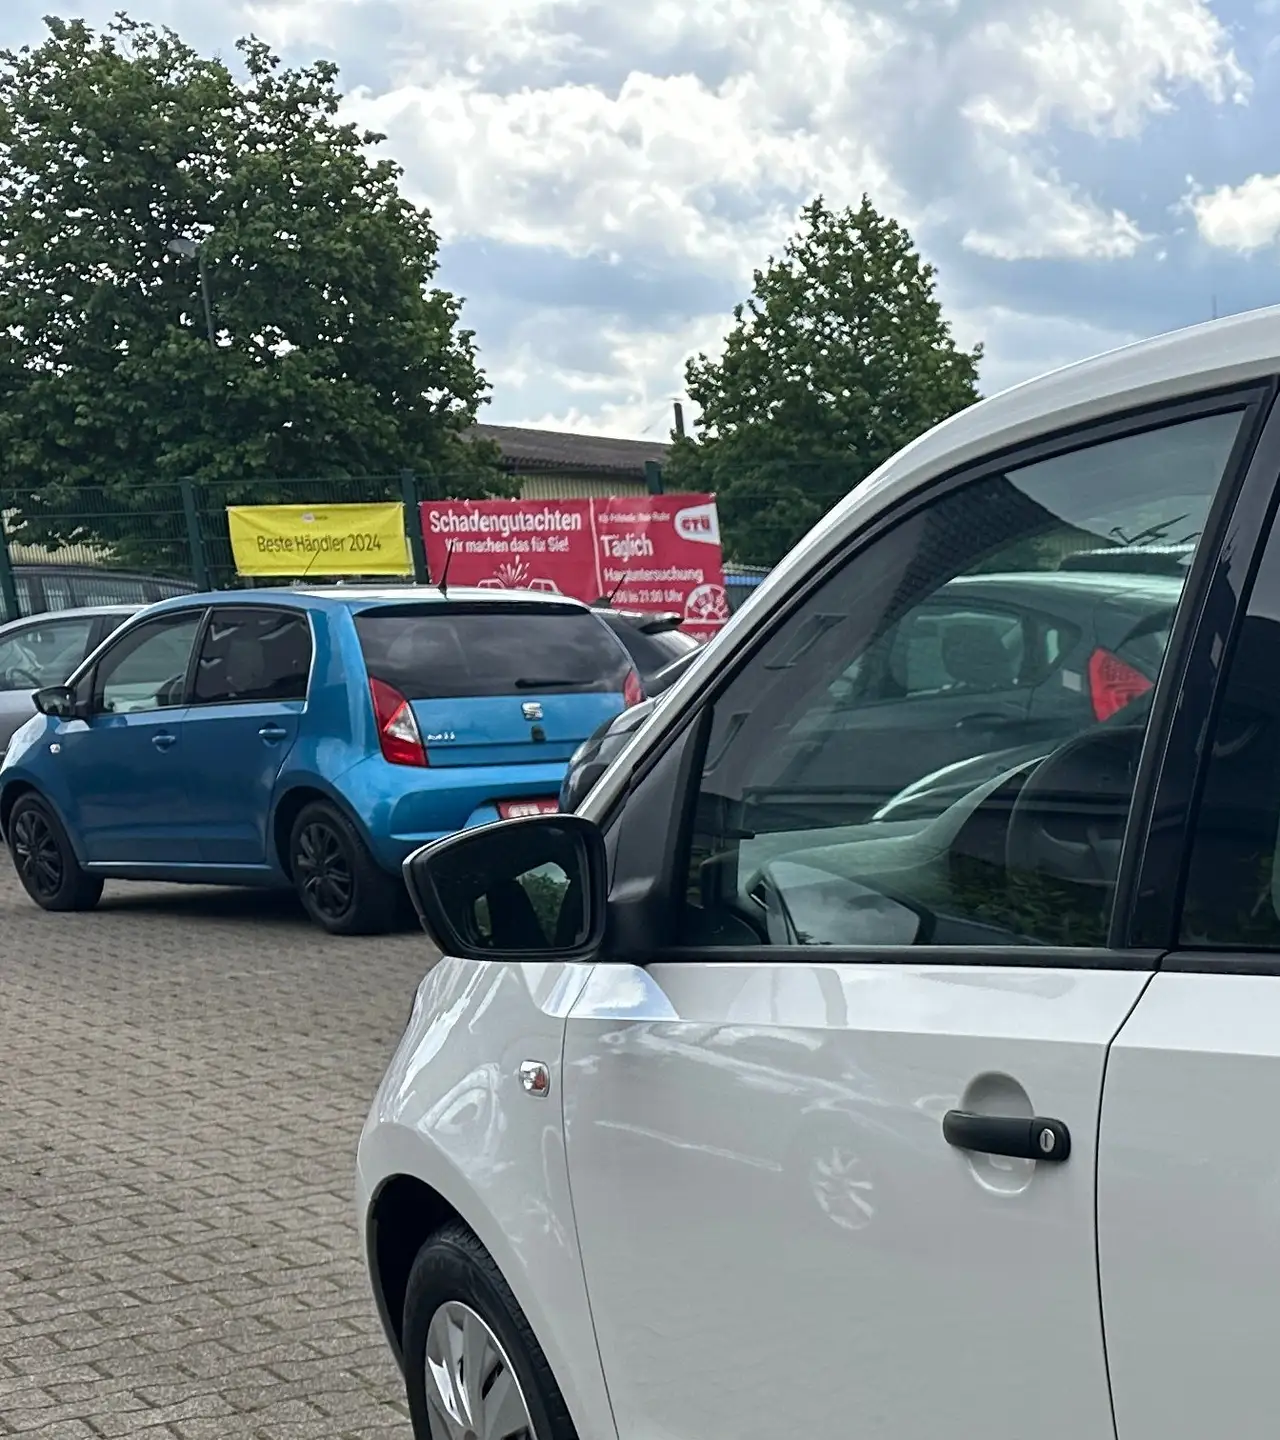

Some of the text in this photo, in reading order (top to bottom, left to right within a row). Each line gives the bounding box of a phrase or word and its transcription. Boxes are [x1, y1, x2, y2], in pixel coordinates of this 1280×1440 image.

[429, 507, 581, 537] Schadengutachten
[680, 515, 711, 532] GTÜ
[257, 534, 382, 553] Beste Händler 2024
[444, 535, 570, 553] Wir machen das für Sie!
[600, 532, 654, 563] Täglich
[664, 589, 685, 603] Uhr
